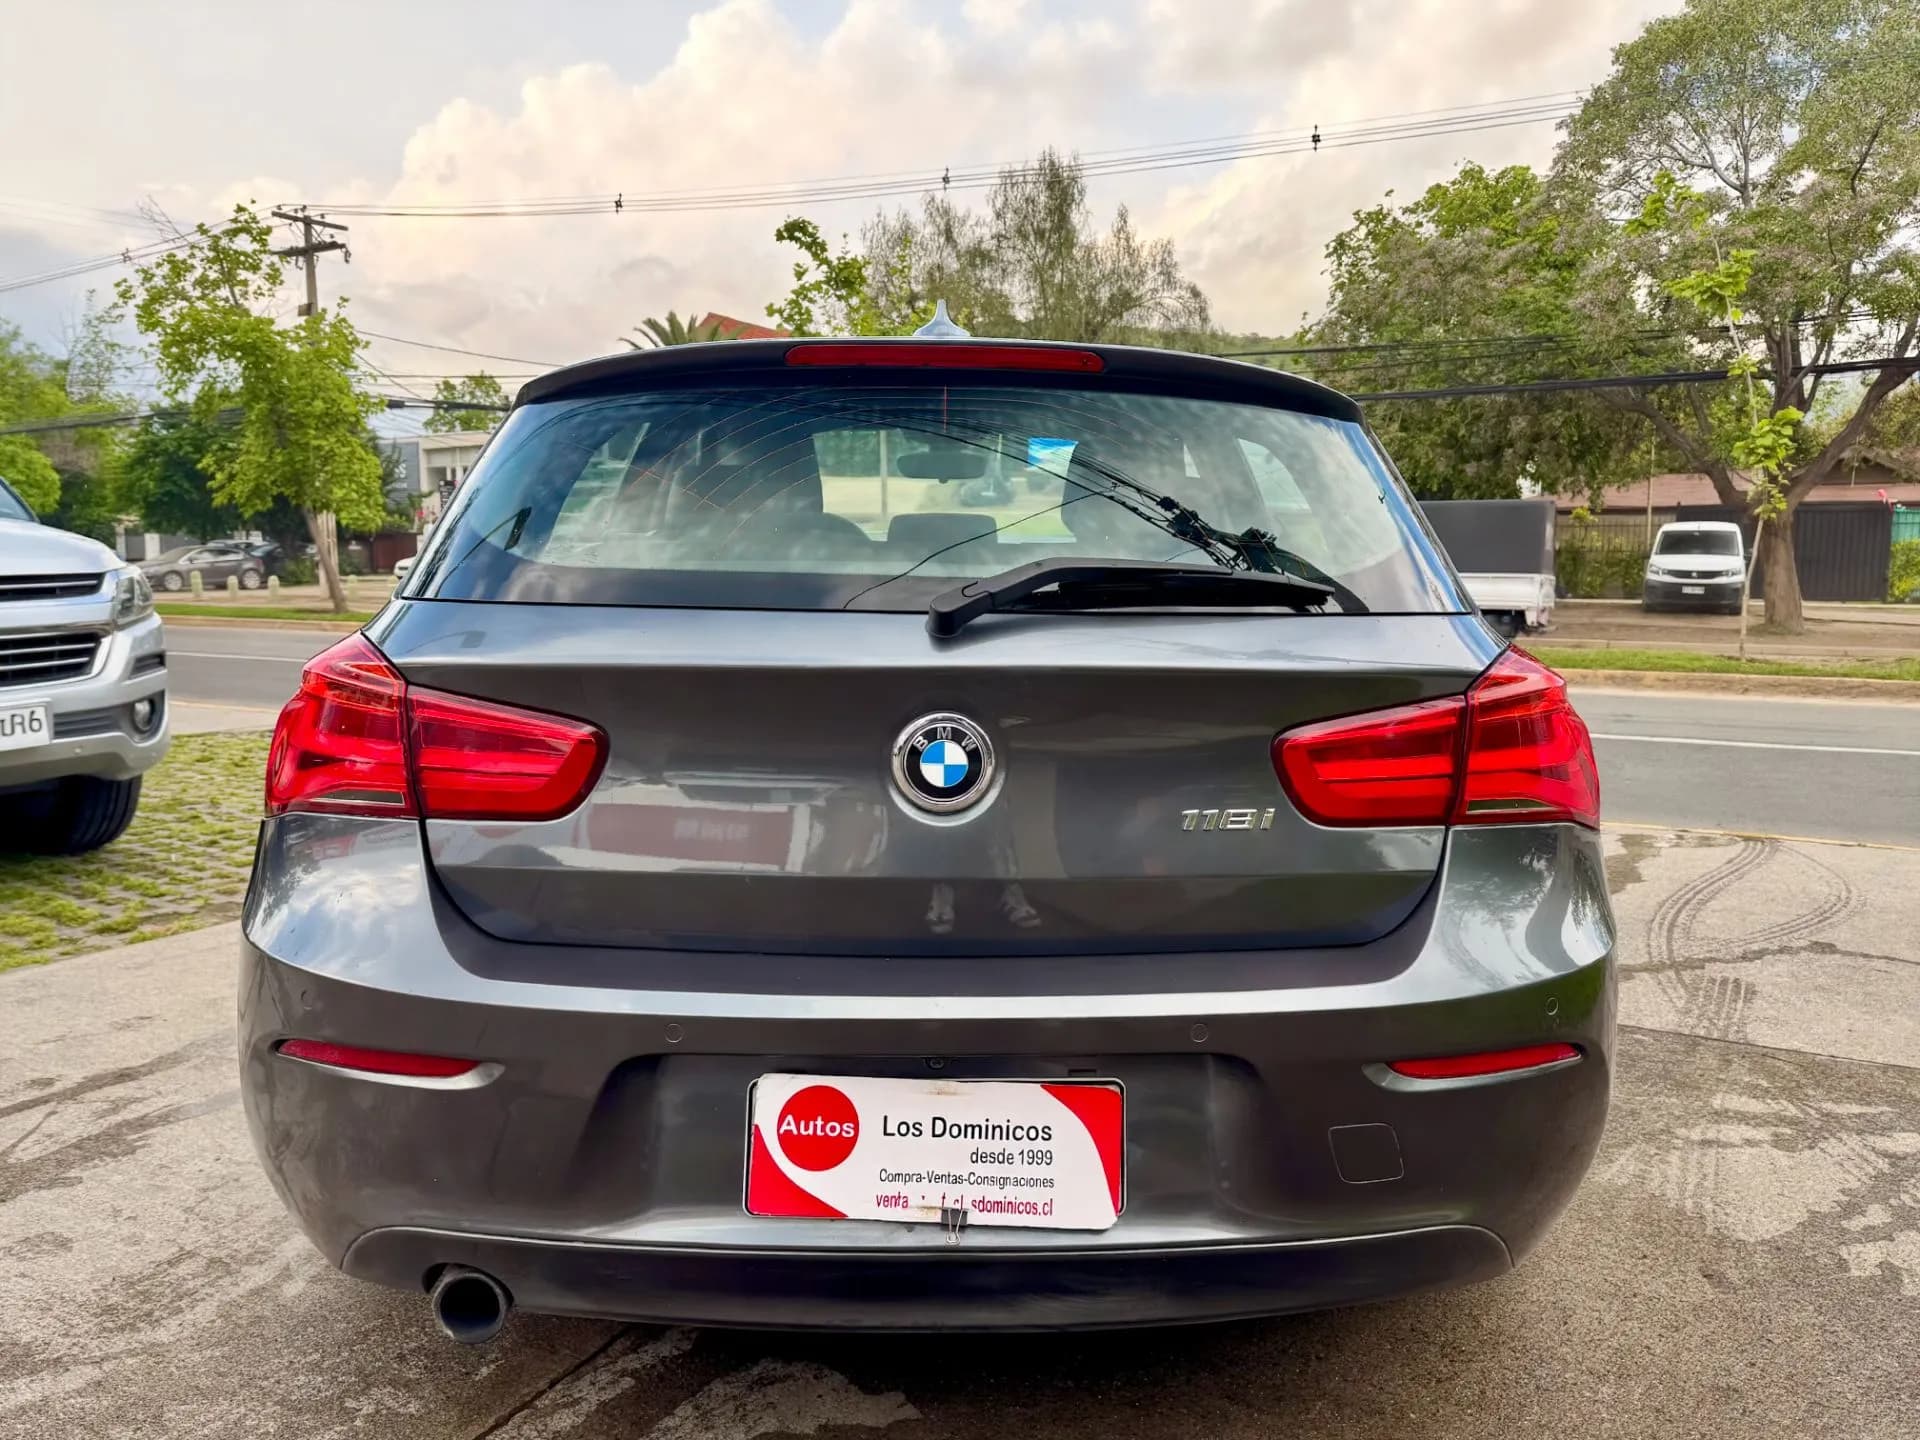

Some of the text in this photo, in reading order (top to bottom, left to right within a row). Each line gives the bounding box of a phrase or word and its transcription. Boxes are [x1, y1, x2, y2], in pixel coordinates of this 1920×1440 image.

[913, 726, 978, 752] BMW
[1181, 807, 1276, 832] 118i
[778, 1115, 856, 1138] Autos
[882, 1115, 1053, 1142] Los Dominicos
[969, 1147, 1054, 1166] desde 1999
[879, 1168, 1055, 1190] Compra-Ventas-Consignaciones
